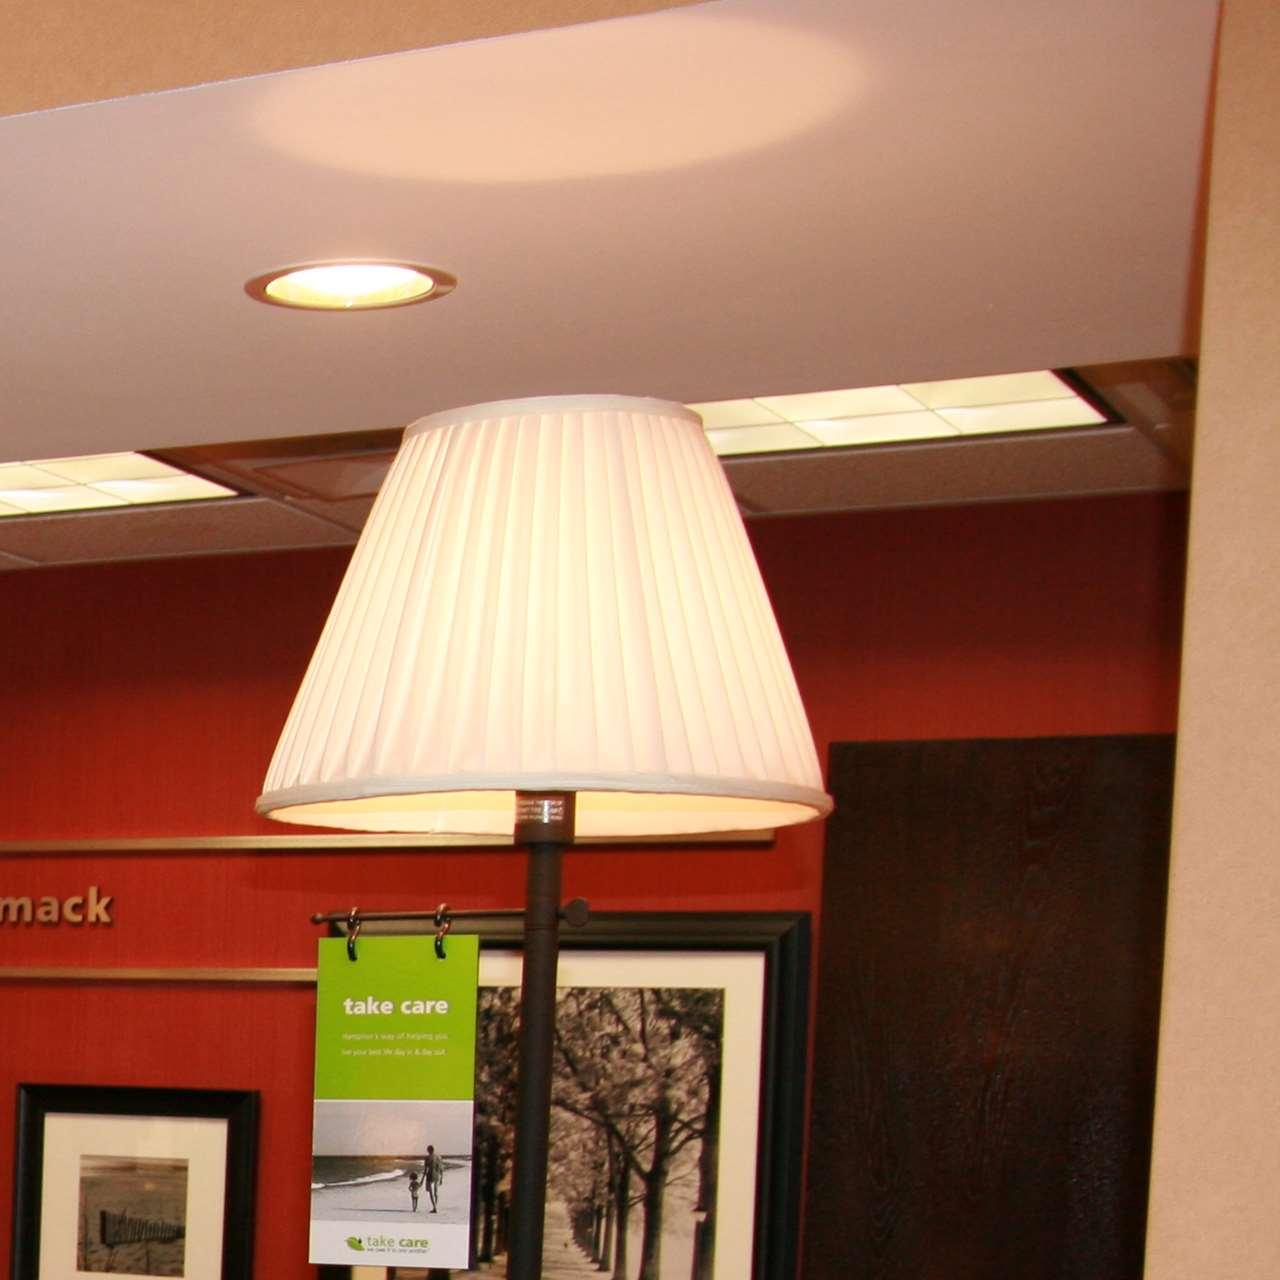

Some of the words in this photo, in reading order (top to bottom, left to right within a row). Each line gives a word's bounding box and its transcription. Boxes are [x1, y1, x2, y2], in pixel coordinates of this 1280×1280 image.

[343, 995, 394, 1015] take
[400, 999, 449, 1015] care
[367, 1235, 395, 1247] take
[399, 1238, 429, 1248] care
